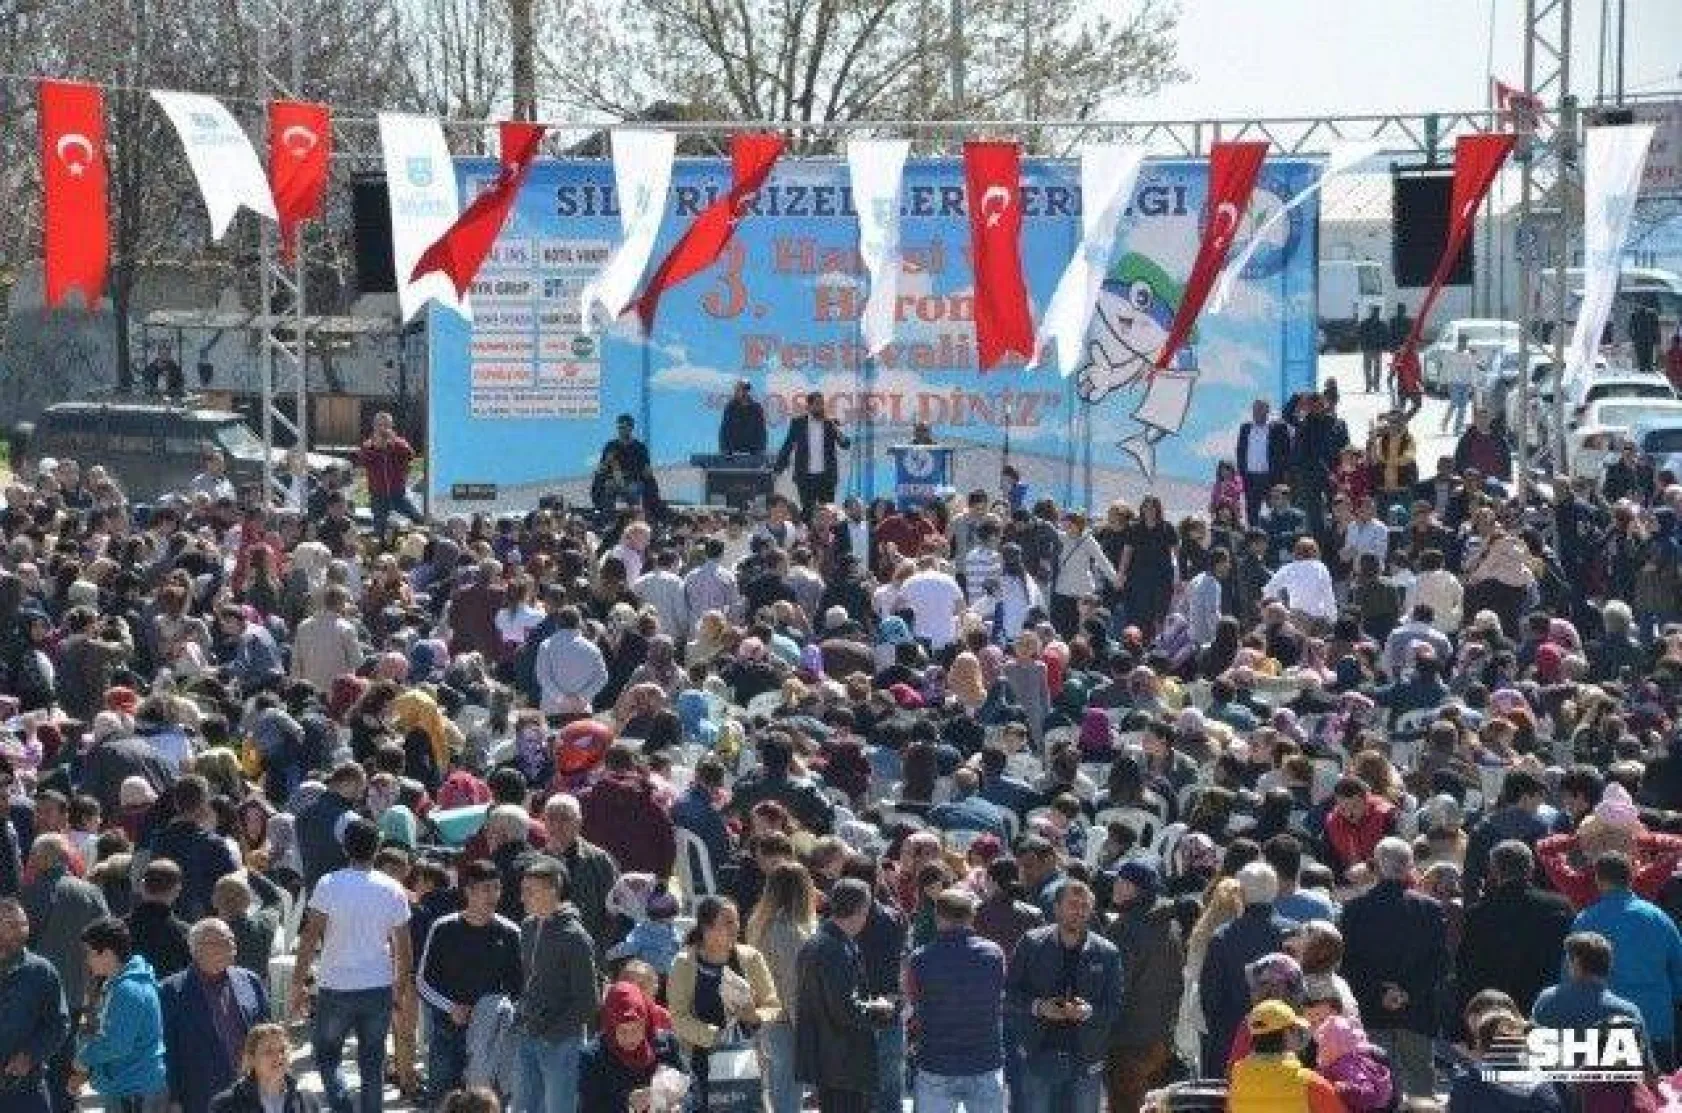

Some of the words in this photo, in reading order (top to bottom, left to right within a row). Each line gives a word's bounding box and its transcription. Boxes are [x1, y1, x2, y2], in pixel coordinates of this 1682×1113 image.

[557, 177, 718, 217] SİLRİ
[747, 176, 966, 217] İZELER
[813, 286, 974, 322] Hron
